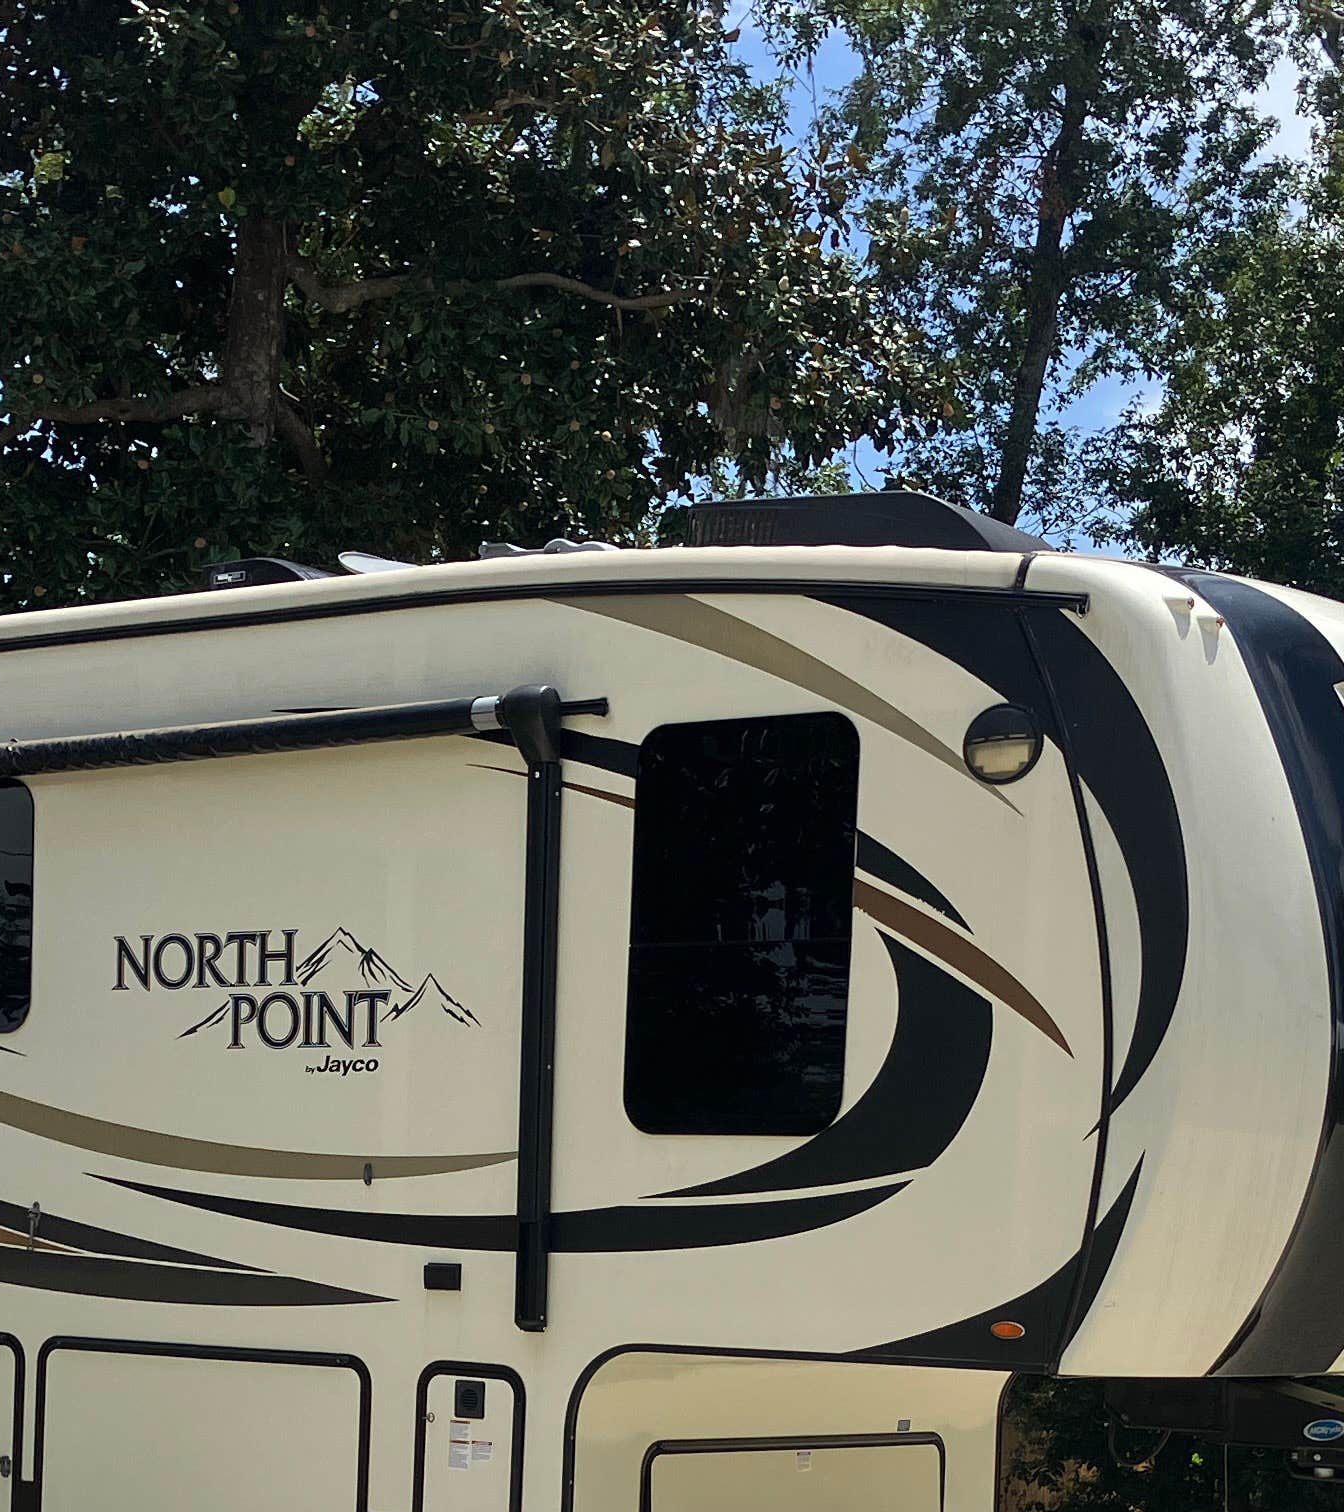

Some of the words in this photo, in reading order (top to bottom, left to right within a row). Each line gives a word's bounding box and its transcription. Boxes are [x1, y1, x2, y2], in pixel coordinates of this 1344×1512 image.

[111, 928, 299, 992] NORTH
[226, 988, 393, 1050] POINT
[305, 1065, 316, 1075] by
[316, 1055, 379, 1077] Jayco
